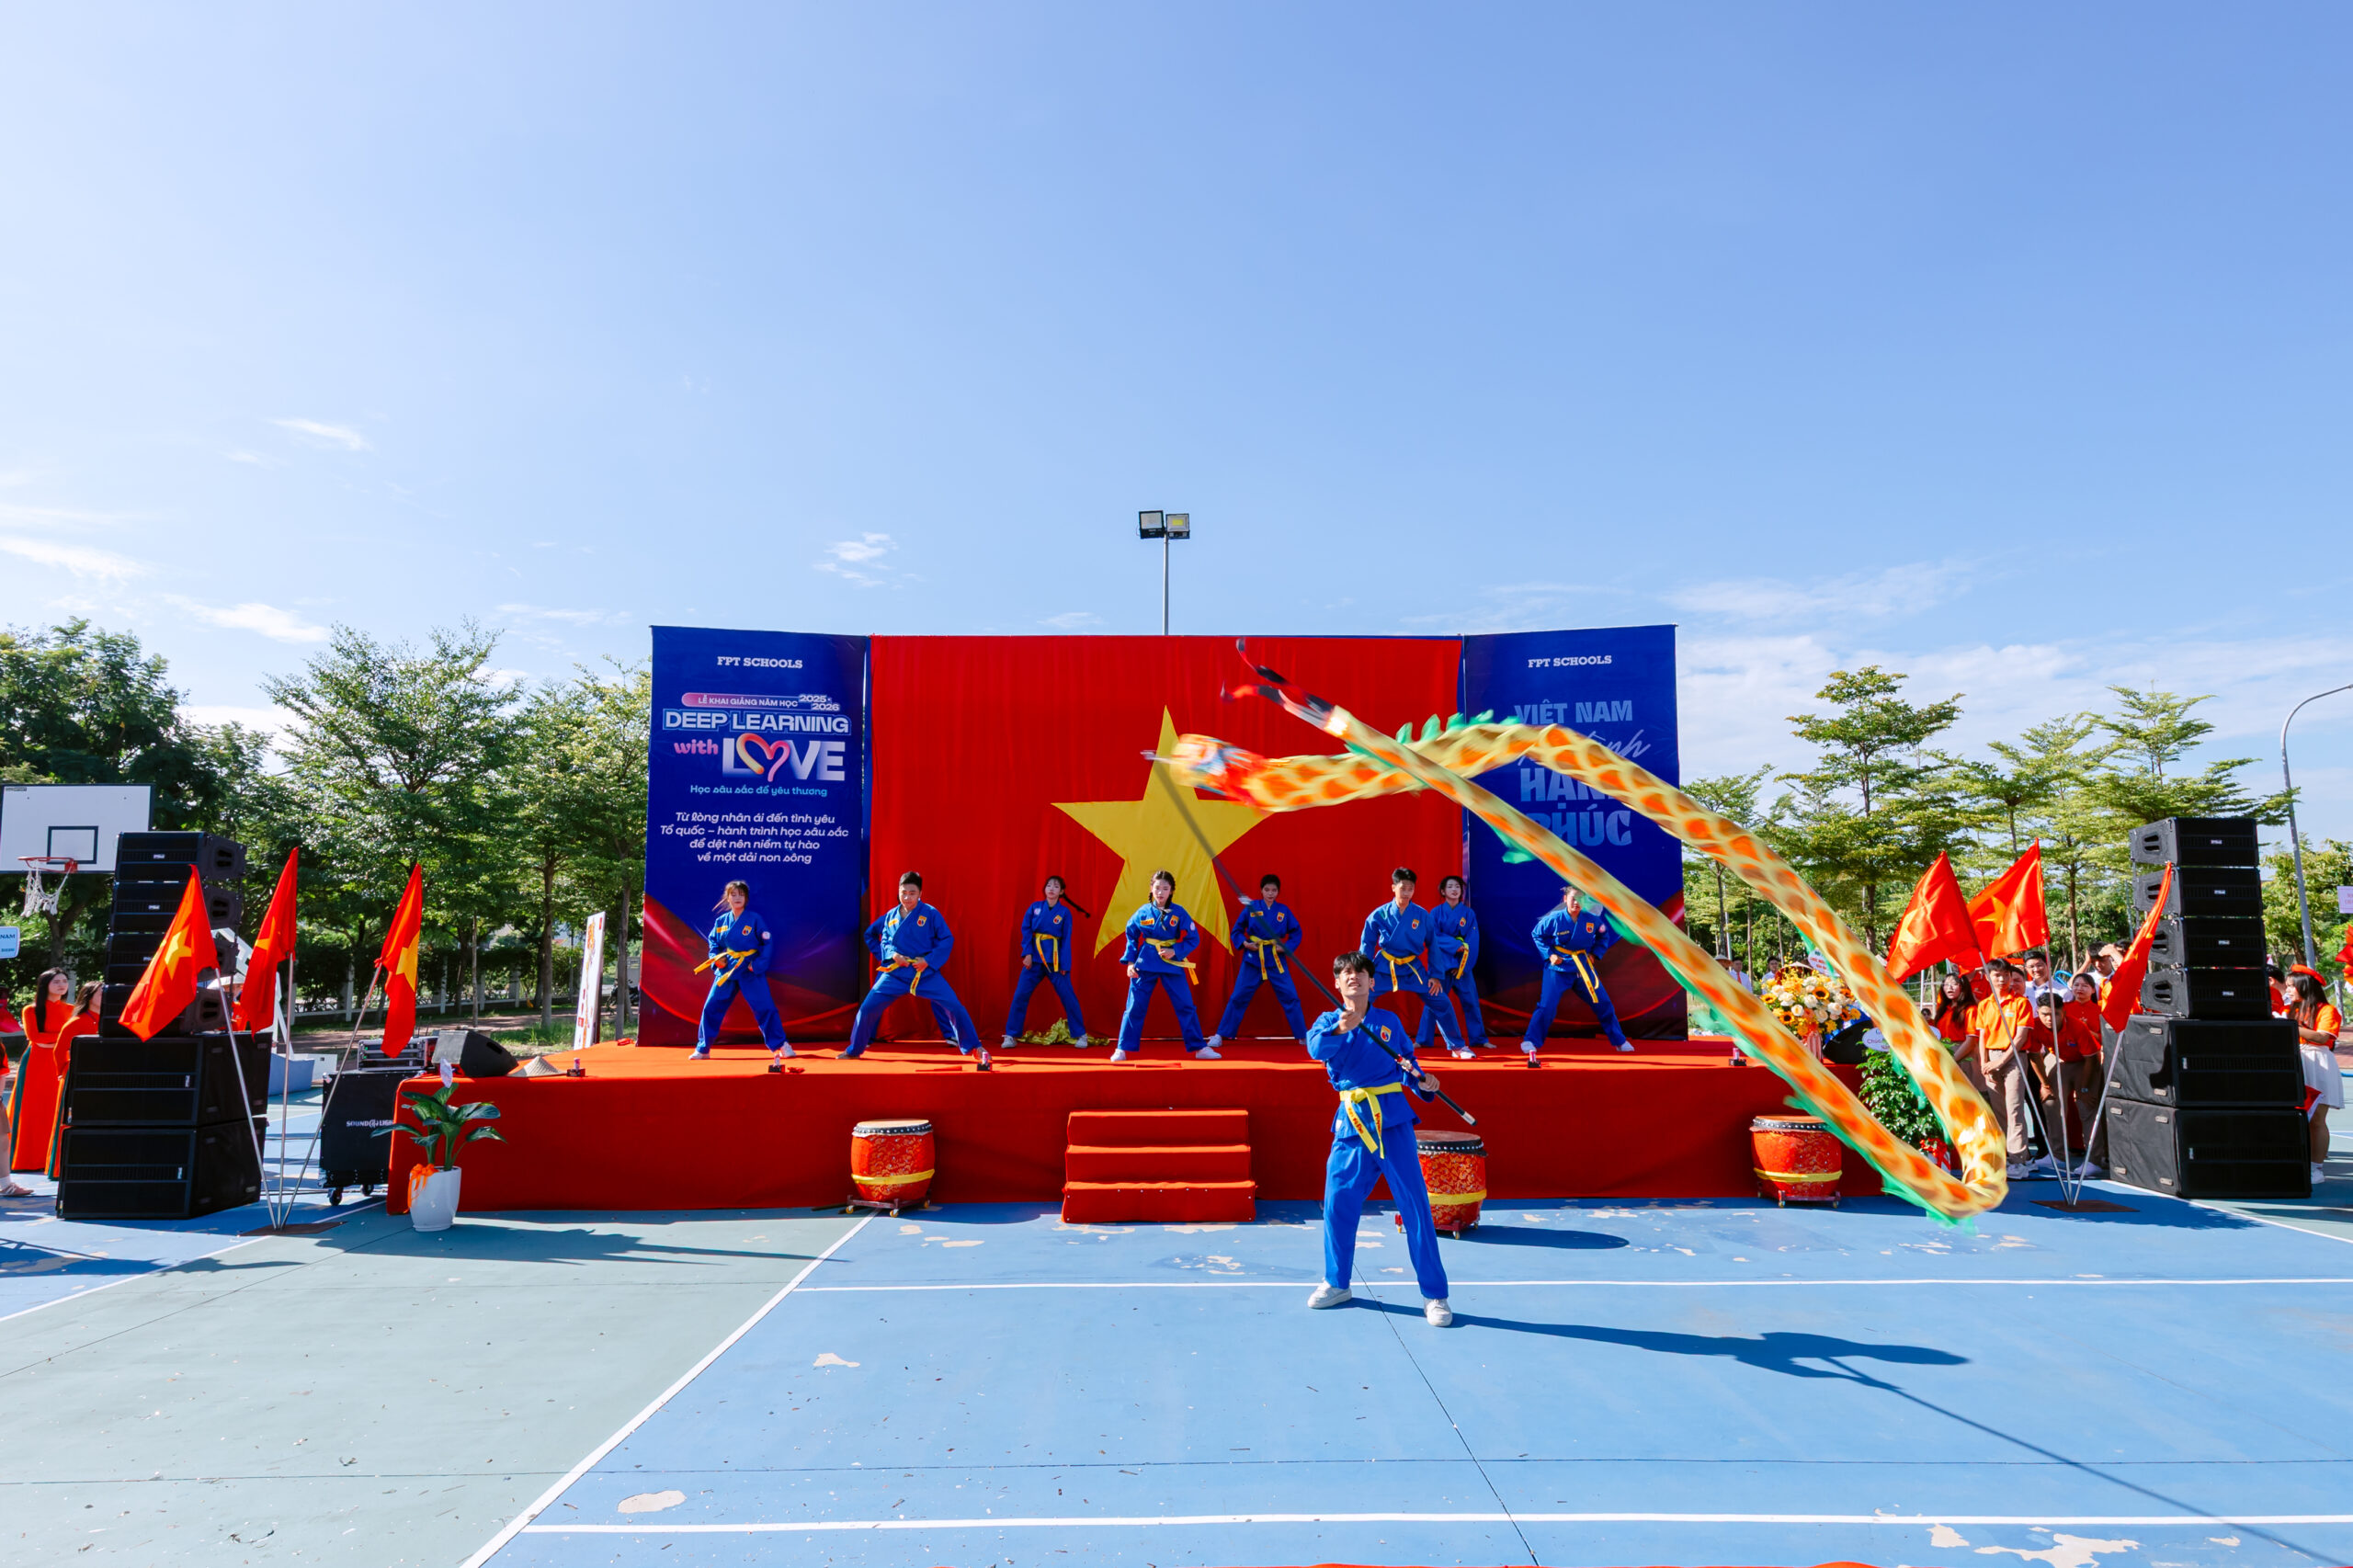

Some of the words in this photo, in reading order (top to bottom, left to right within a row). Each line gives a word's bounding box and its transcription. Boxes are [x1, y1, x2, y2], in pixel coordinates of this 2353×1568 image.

[718, 656, 741, 666] FPT
[743, 657, 803, 669] SCHOOLS
[1528, 658, 1551, 668] FPT
[1552, 655, 1612, 666] SCHOOLS
[699, 694, 708, 704] LỄ
[709, 697, 729, 705] KHAI
[730, 697, 758, 706] GIẢNG
[758, 699, 779, 707] NĂM
[779, 699, 798, 709] HỌC
[812, 702, 840, 711] 2026
[1575, 700, 1633, 723] NAM
[665, 711, 728, 729] DEEP
[732, 713, 849, 733] LEARNING
[673, 738, 719, 756] with
[690, 785, 711, 795] Học
[712, 785, 733, 794] sâu
[734, 784, 755, 794] sắc
[771, 786, 790, 797] yêu
[791, 787, 828, 797] thương
[676, 812, 690, 822] Từ
[691, 812, 720, 824] lòng
[721, 812, 752, 823] nhân
[753, 812, 765, 823] ái
[766, 812, 789, 823] đến
[790, 813, 813, 824] tình
[813, 814, 835, 825] yêu
[660, 824, 675, 835] Tổ
[675, 824, 706, 837] quốc
[717, 825, 747, 835] hành
[749, 826, 779, 835] trình
[779, 826, 802, 838] học
[803, 827, 825, 836] sâu
[827, 825, 849, 837] sắc
[707, 838, 728, 850] dệt
[729, 839, 752, 848] nên
[753, 838, 781, 849] niềm
[784, 840, 797, 851] tự
[797, 839, 820, 849] hào
[697, 851, 711, 862] về
[712, 852, 736, 864] một
[738, 851, 757, 862] dải
[758, 854, 781, 862] non
[782, 853, 813, 865] sông
